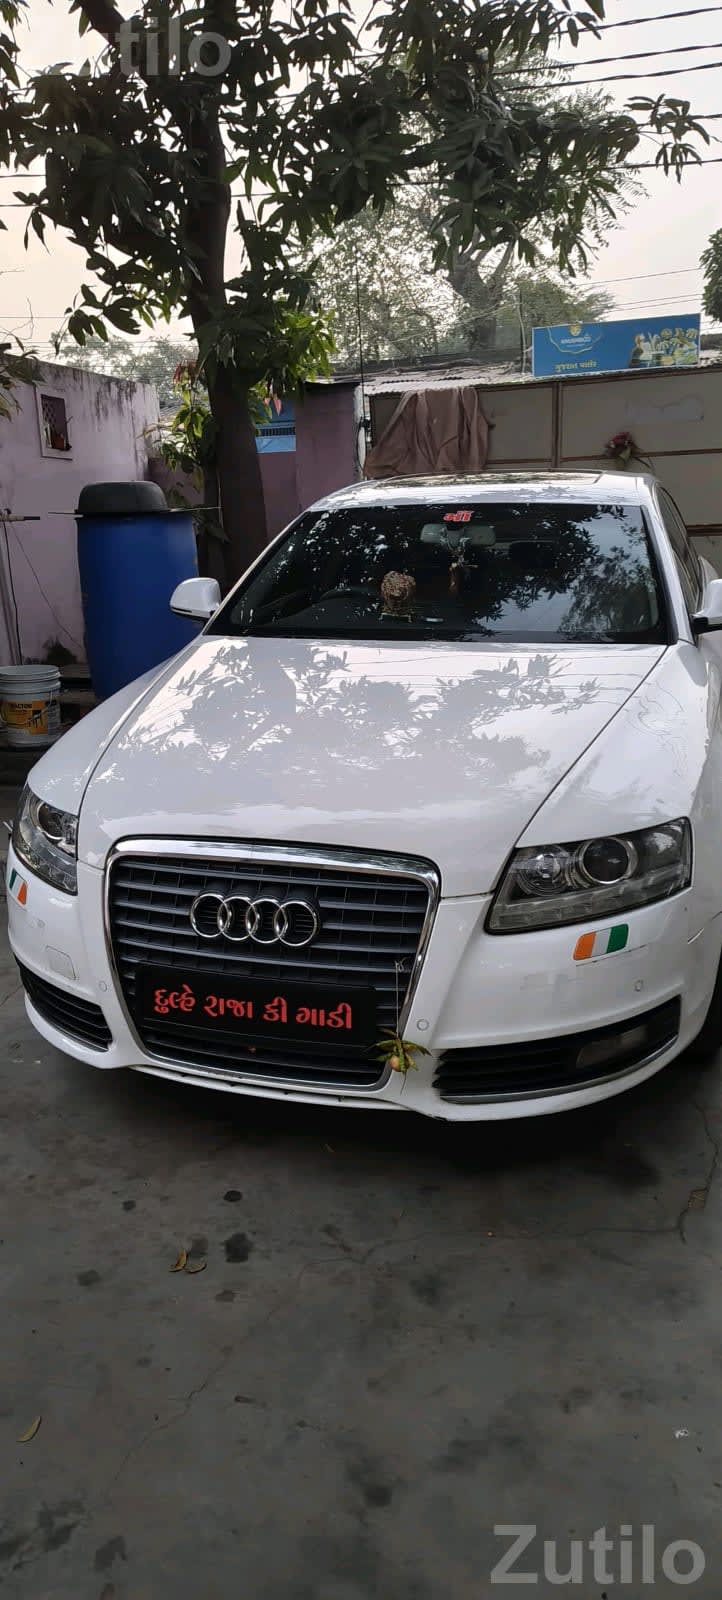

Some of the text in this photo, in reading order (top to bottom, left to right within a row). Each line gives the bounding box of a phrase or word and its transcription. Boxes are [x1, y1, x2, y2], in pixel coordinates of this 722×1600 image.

[153, 983, 353, 1030] દુલ્હે રાજા કી ગાડી
